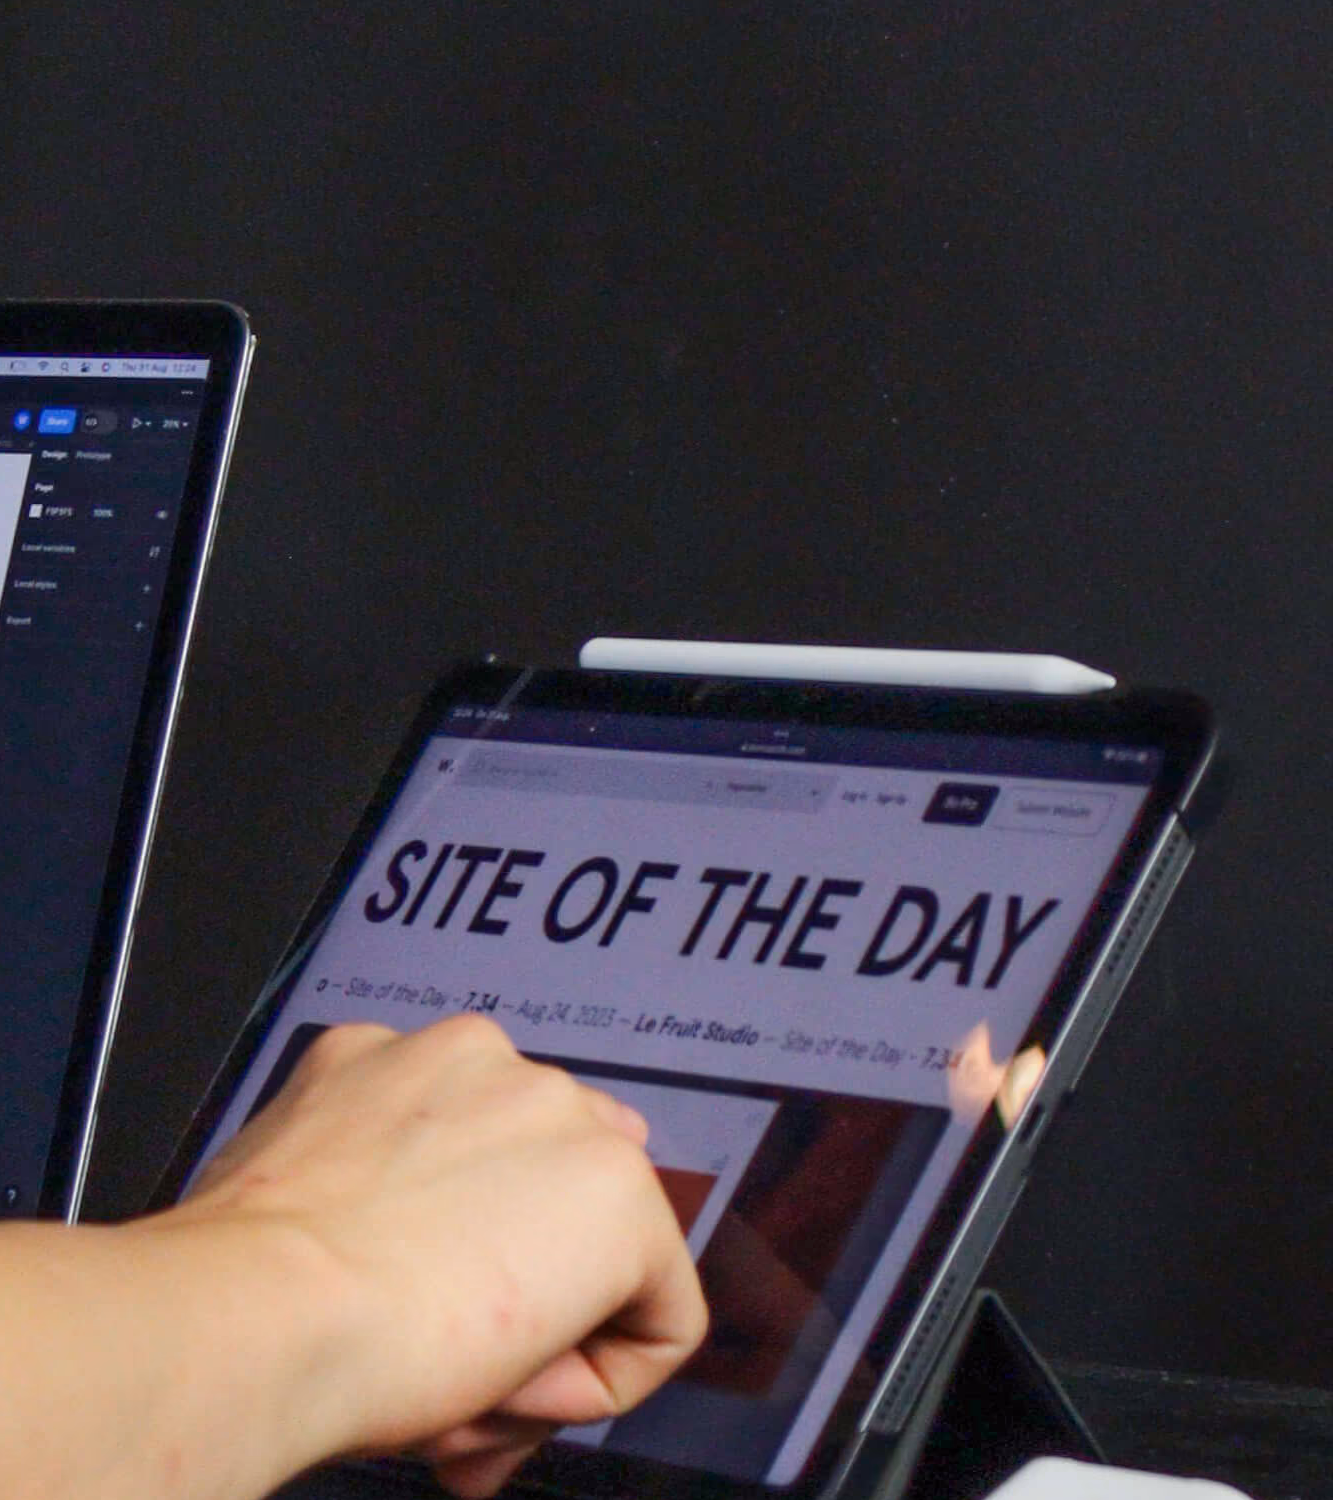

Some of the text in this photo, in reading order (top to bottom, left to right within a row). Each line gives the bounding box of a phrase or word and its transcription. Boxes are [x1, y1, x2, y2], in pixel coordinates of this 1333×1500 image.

[364, 839, 1060, 990] SITE OF THE DAY
[634, 1013, 656, 1033] Le
[658, 1015, 702, 1039] Fruit
[702, 1020, 759, 1046] Studio
